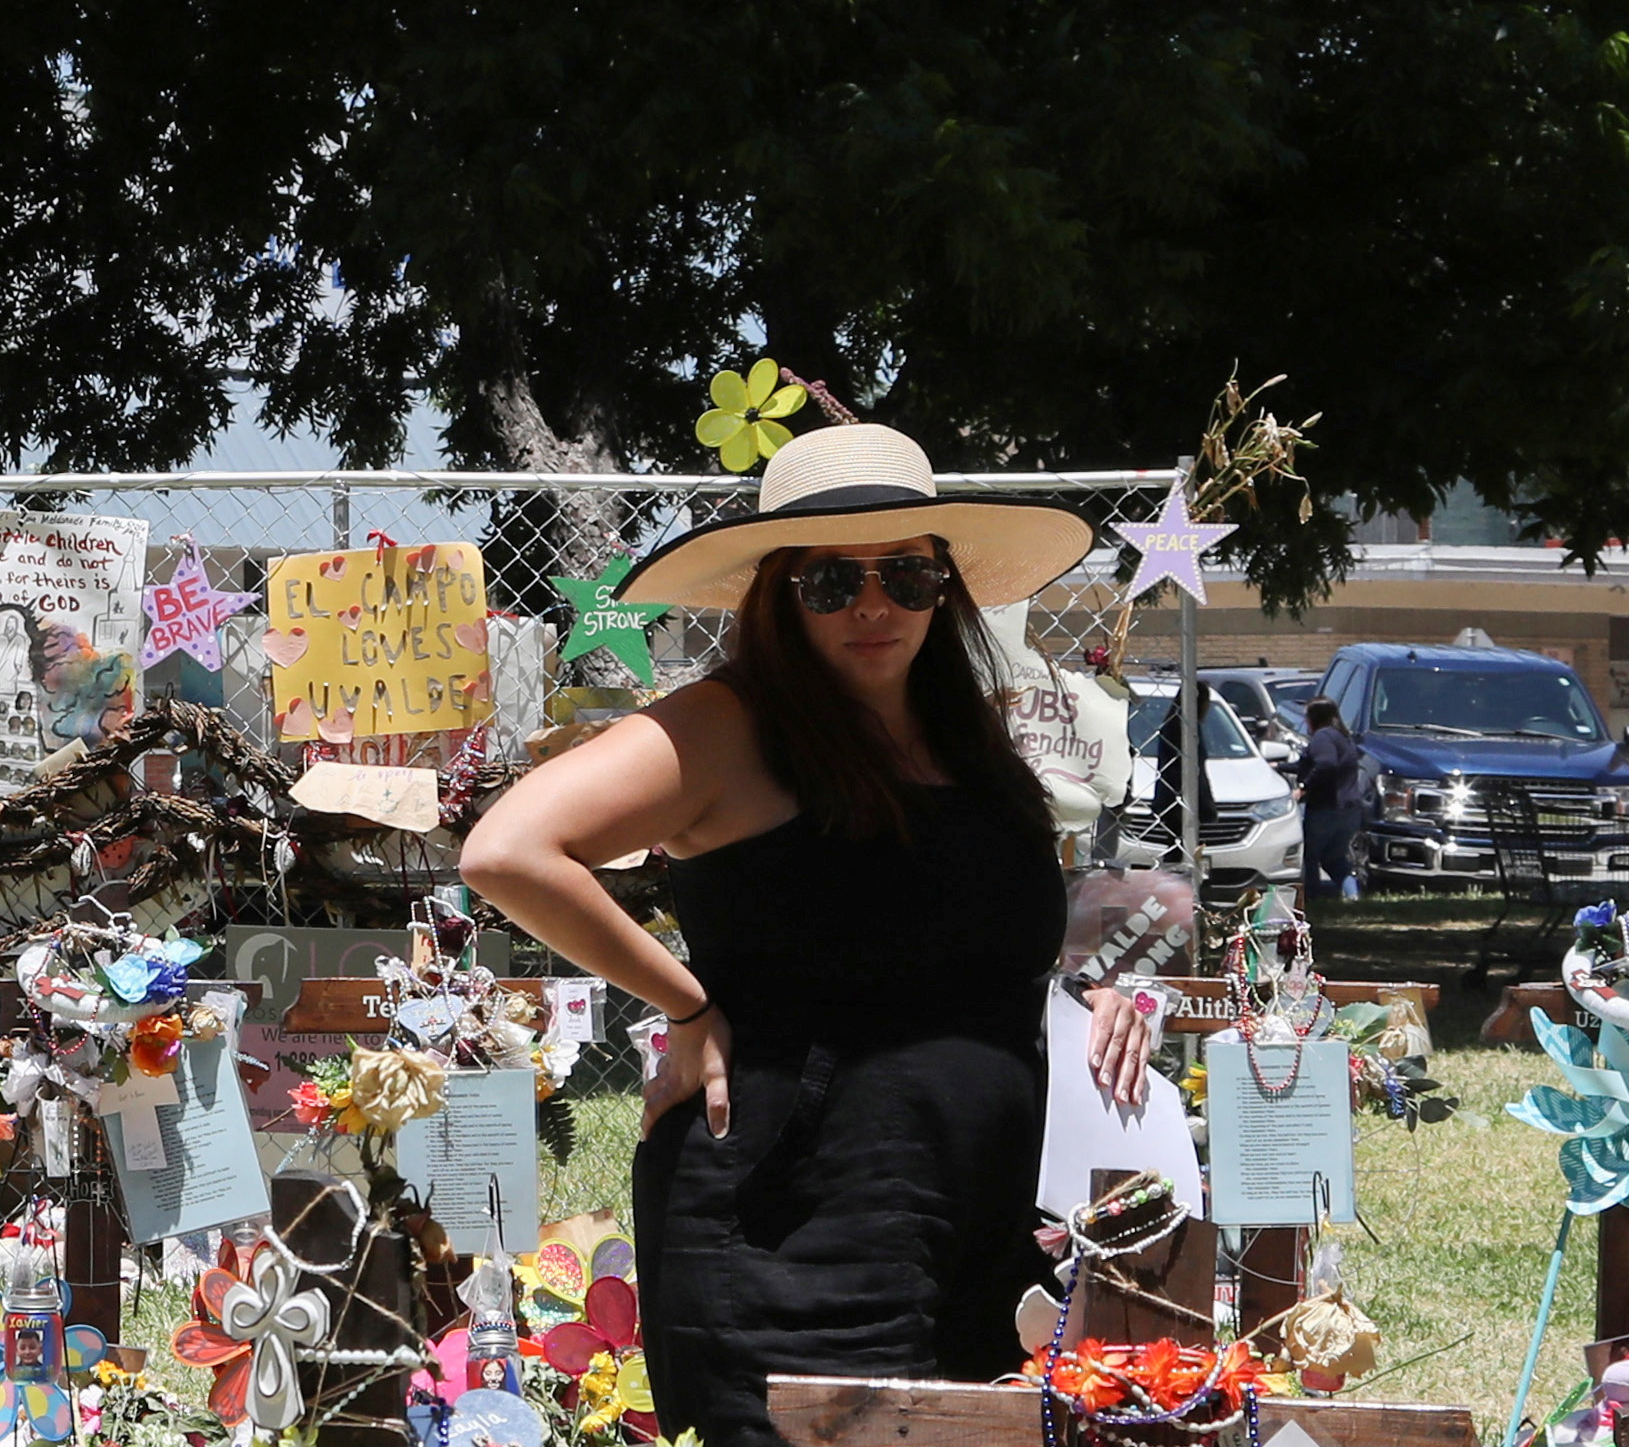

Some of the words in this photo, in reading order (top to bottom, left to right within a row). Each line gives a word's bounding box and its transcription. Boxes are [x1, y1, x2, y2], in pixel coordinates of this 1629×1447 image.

[17, 549, 48, 566] and
[56, 553, 74, 568] do
[79, 556, 116, 572] not
[1145, 532, 1201, 552] PEACE
[6, 570, 31, 586] for
[32, 571, 88, 590] theirs
[94, 576, 112, 590] is
[12, 588, 31, 604] of
[38, 595, 82, 613] GOD
[153, 575, 211, 623] BE
[285, 578, 332, 619] EL
[359, 565, 477, 617] CAMPO
[150, 596, 228, 652] BRAVE
[342, 621, 453, 667] LOVES
[584, 611, 649, 636] STRONG
[307, 673, 469, 721] UVALDE
[1078, 894, 1168, 982] VALDE
